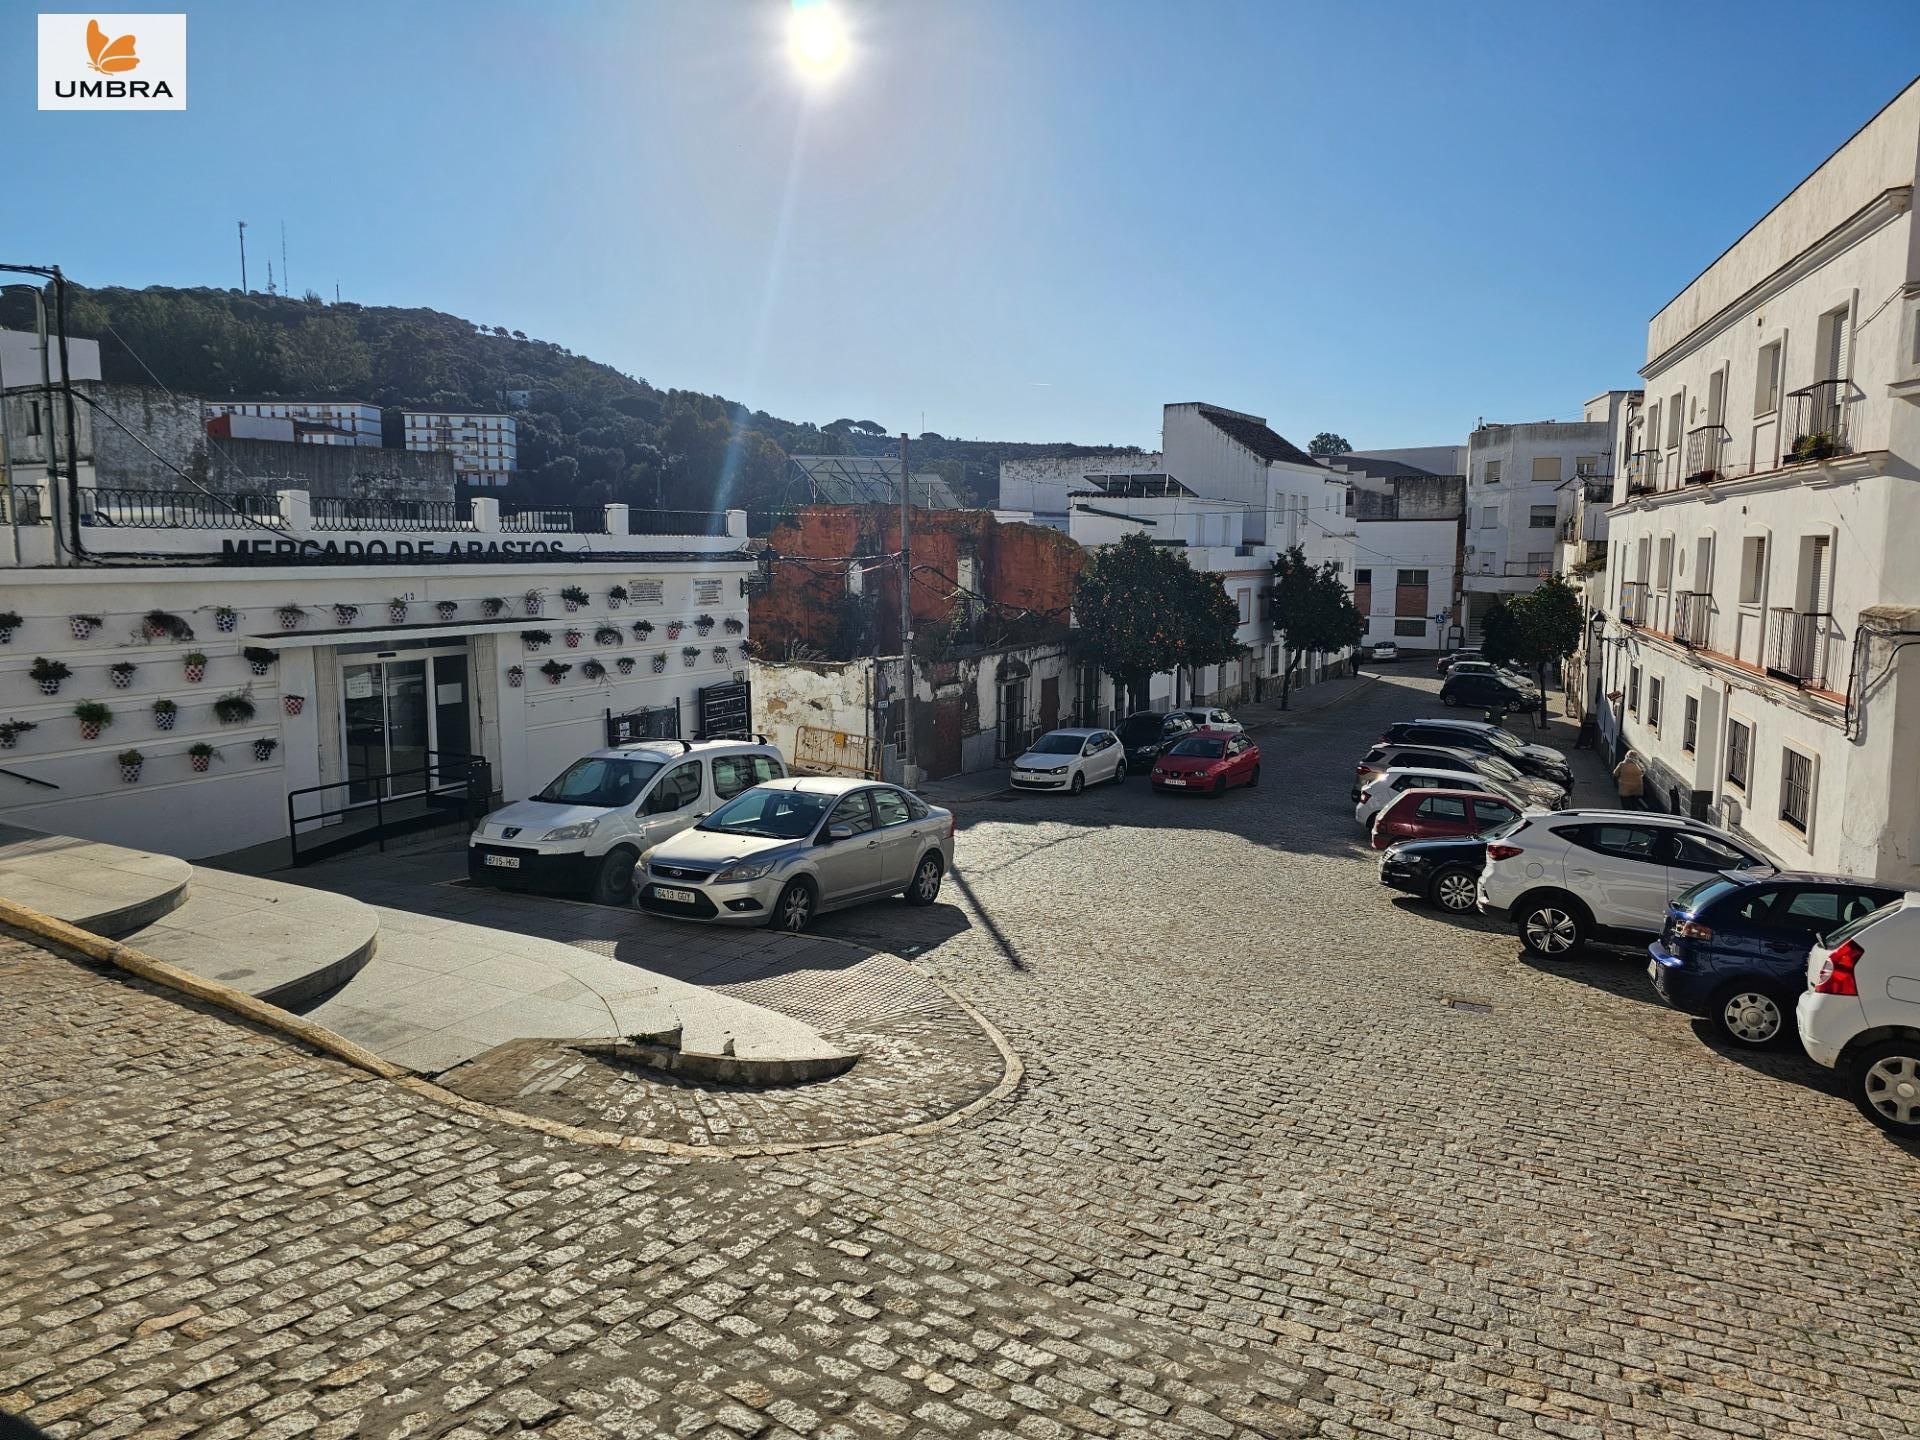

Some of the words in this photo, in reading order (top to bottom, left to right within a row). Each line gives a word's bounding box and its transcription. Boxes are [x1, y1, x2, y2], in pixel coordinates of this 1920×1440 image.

[222, 539, 388, 562] MERCADO
[395, 540, 435, 561] DE
[448, 540, 564, 560] ABASTOS
